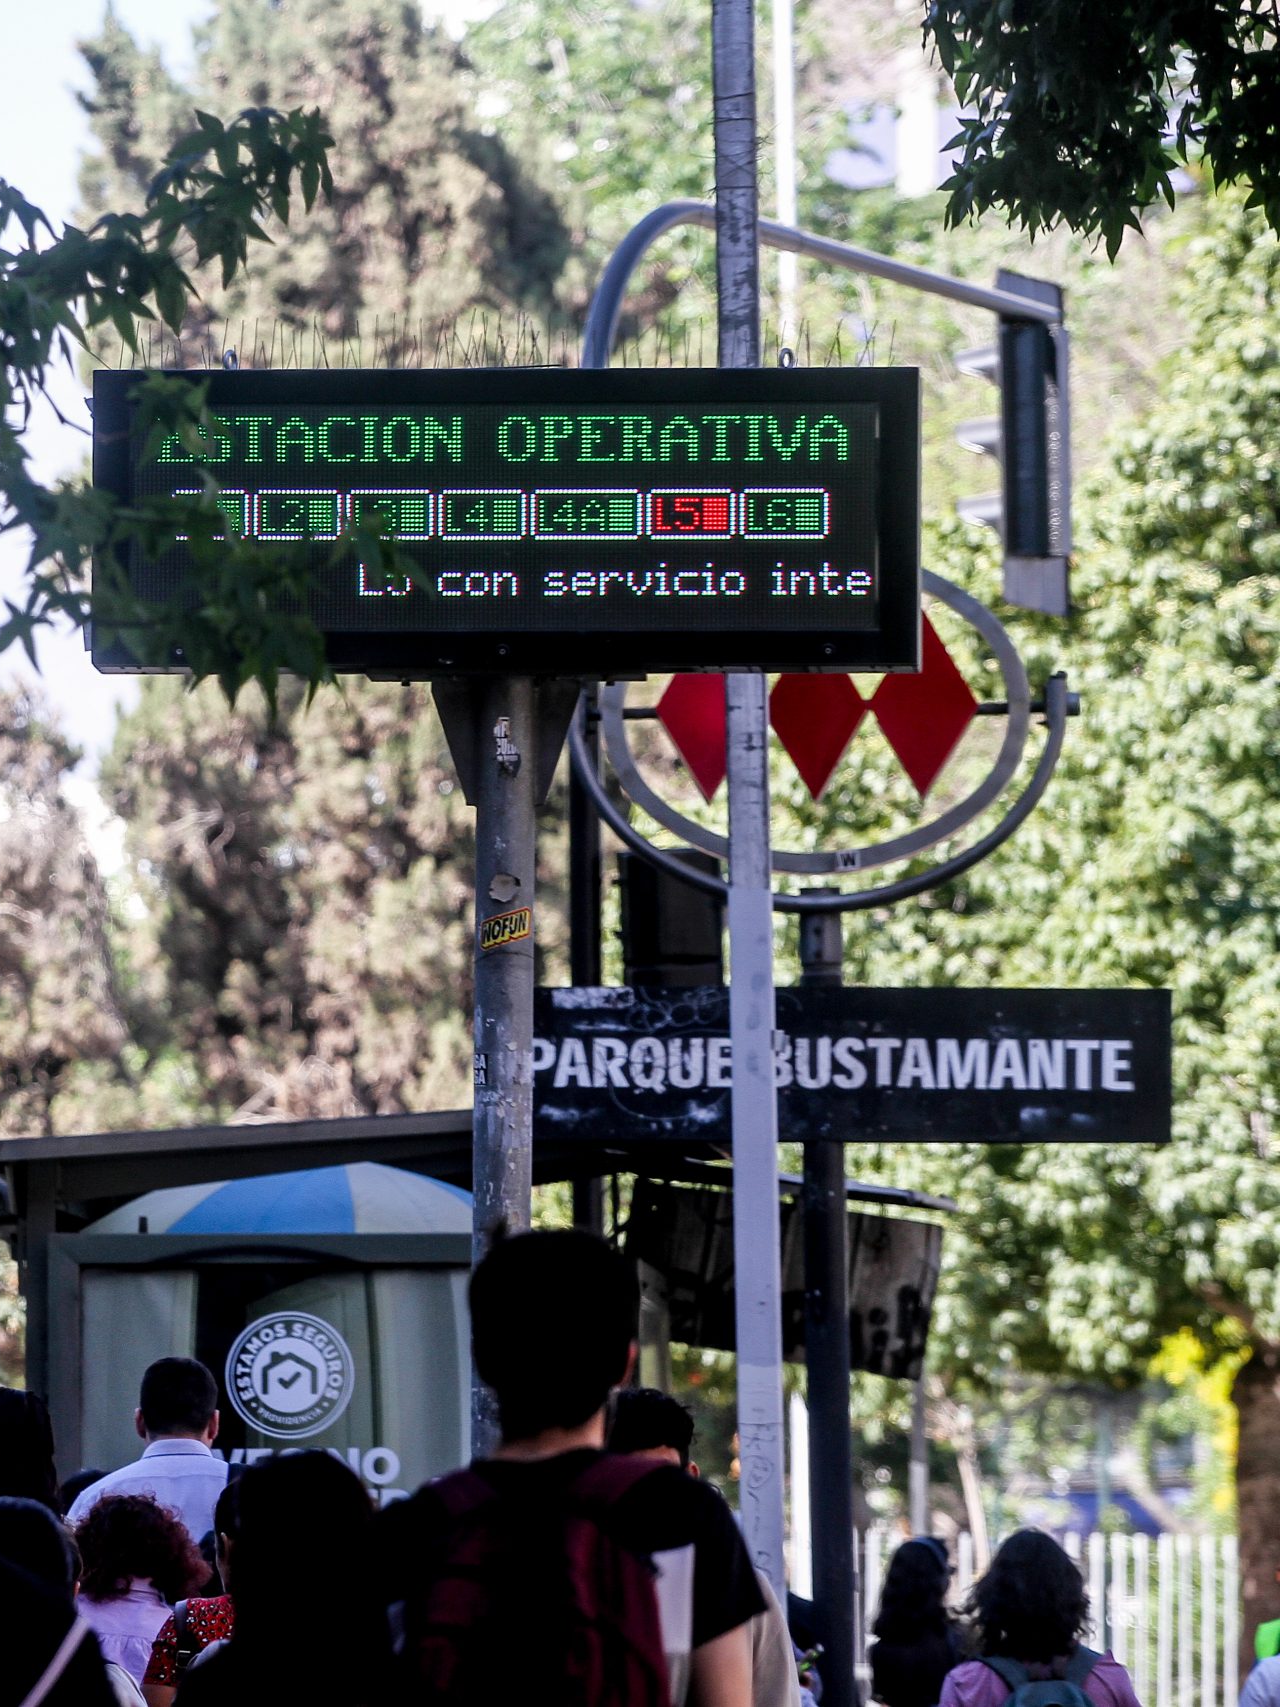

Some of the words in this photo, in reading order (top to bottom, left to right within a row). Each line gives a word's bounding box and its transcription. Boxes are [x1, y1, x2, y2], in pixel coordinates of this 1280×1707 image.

[497, 415, 848, 463] OPERATIVA
[261, 499, 304, 532] L2
[446, 499, 489, 532] L4
[538, 499, 606, 531] L4A
[655, 497, 700, 531] L5
[747, 498, 792, 531] L6
[436, 571, 518, 596] con
[543, 562, 747, 597] servicio
[771, 561, 873, 597] inte
[532, 1036, 733, 1094] PARQUE
[236, 1323, 288, 1401] ESTAMOS
[291, 1323, 343, 1400] SEGUROS
